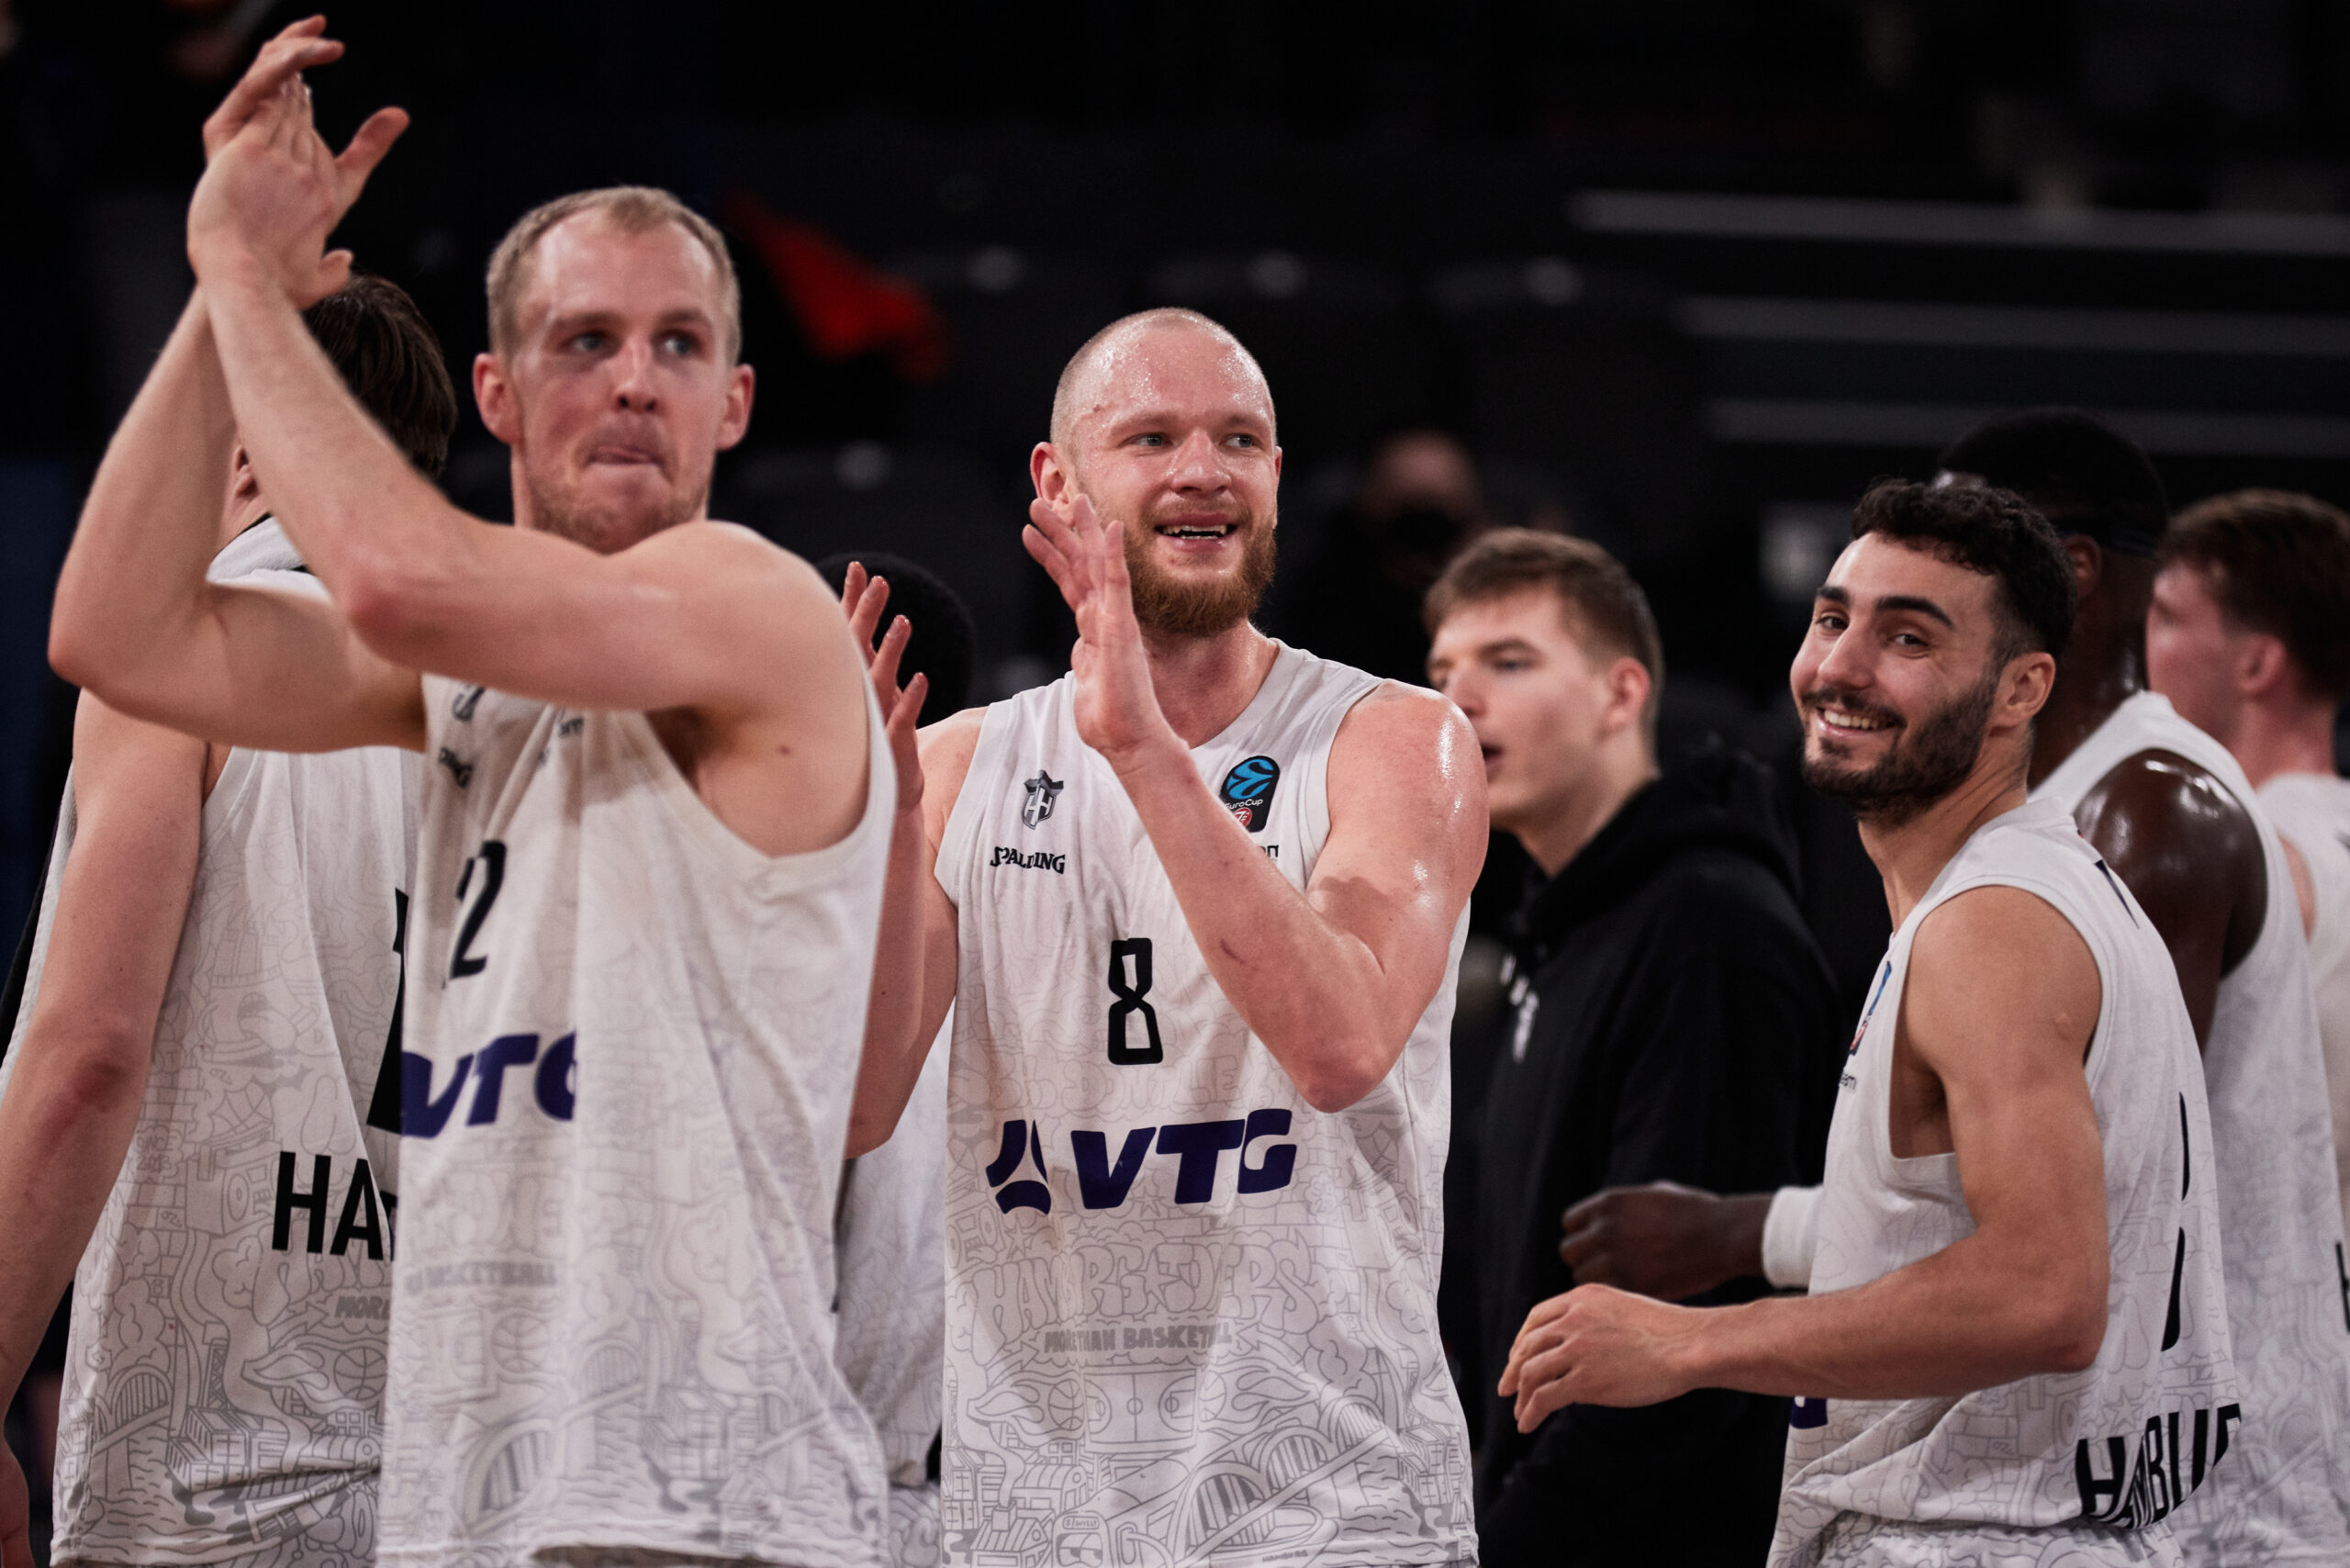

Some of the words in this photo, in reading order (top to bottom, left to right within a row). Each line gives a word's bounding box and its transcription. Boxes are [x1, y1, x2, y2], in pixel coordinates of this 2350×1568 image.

[990, 846, 1065, 875] SPALDING
[1108, 937, 1164, 1066] 8
[1070, 1108, 1298, 1210] VTG
